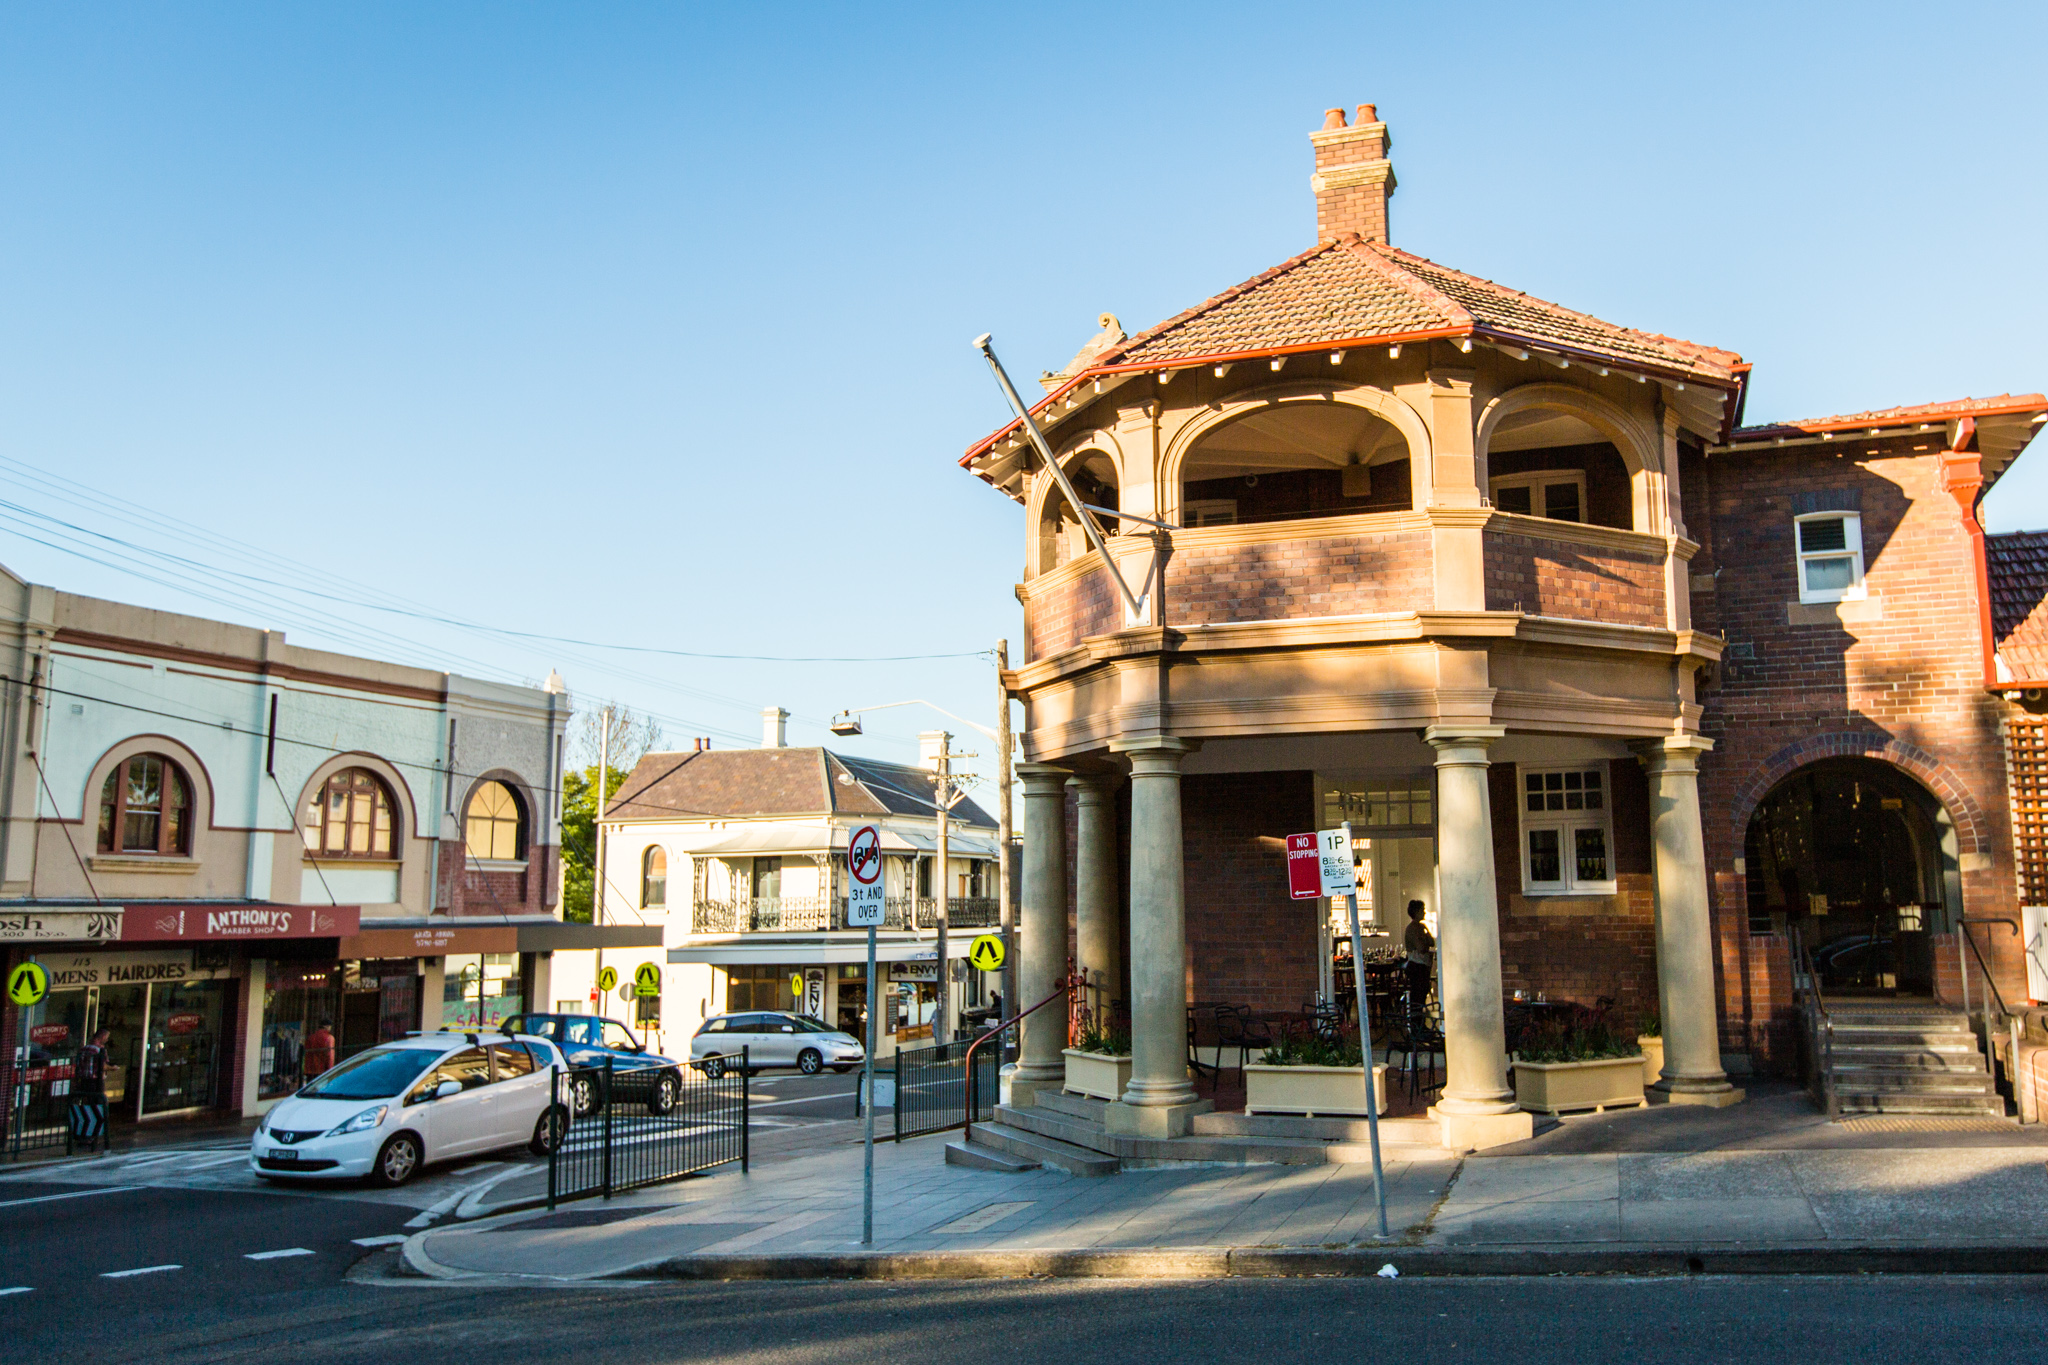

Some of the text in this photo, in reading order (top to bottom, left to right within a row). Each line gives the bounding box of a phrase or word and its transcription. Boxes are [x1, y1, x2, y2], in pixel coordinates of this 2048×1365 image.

[1296, 837, 1309, 848] NO
[1328, 836, 1344, 850] 1P
[1289, 849, 1319, 860] STOPPING
[852, 886, 882, 900] 3t AND
[858, 904, 878, 918] OVER
[222, 927, 251, 935] BARBER
[53, 962, 186, 985] MENS HAIRDRES
[910, 964, 938, 974] ENVY
[456, 1010, 501, 1030] SALE
